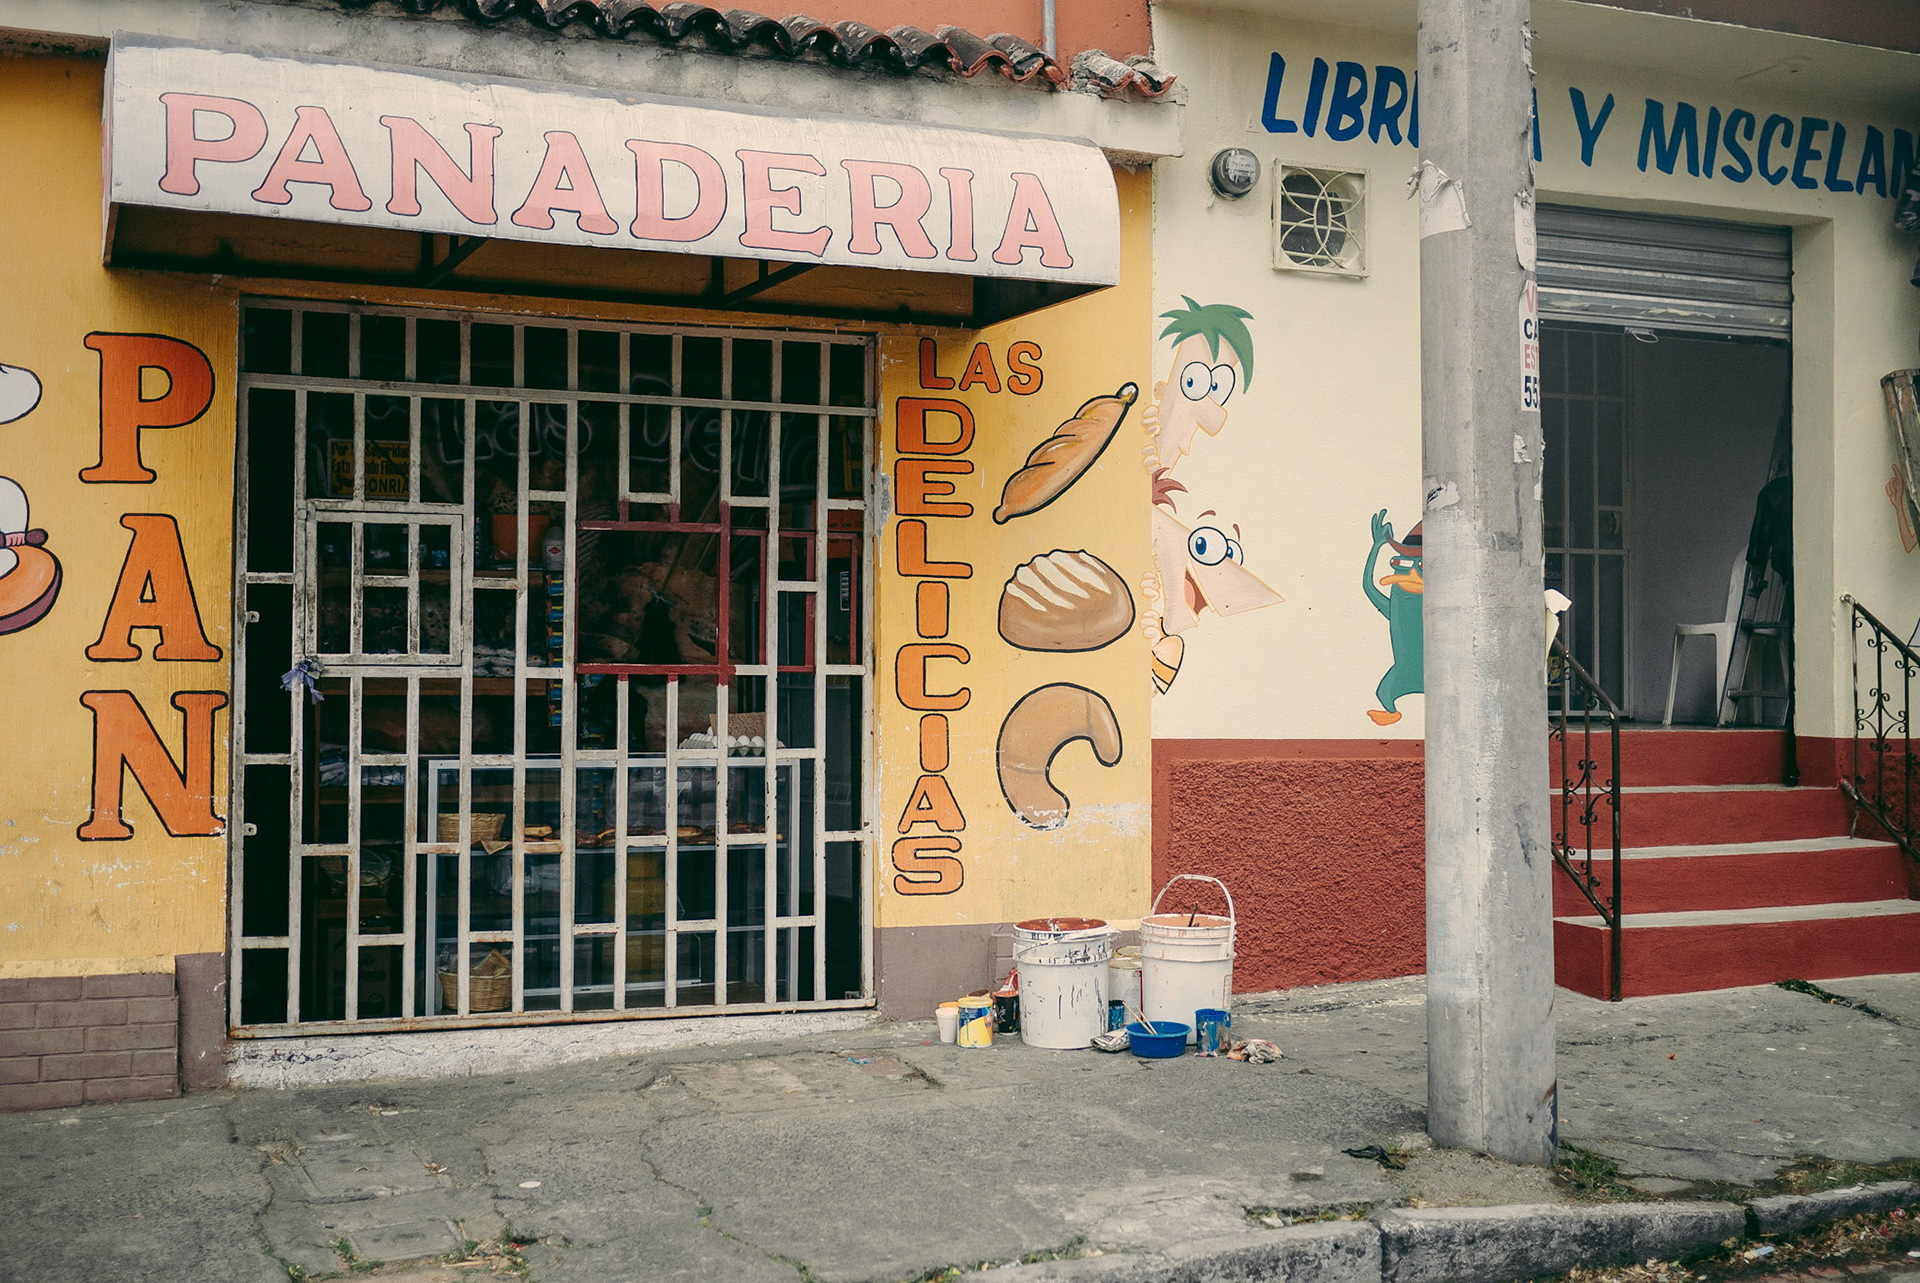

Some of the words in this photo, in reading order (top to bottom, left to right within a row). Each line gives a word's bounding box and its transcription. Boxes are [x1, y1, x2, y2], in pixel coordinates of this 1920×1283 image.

[158, 92, 1073, 269] PANADERIA
[1569, 86, 1615, 167] Y
[919, 338, 1043, 395] LAS
[364, 478, 410, 494] ONRIA
[77, 331, 230, 841] PAN
[892, 396, 975, 896] DELICIAS
